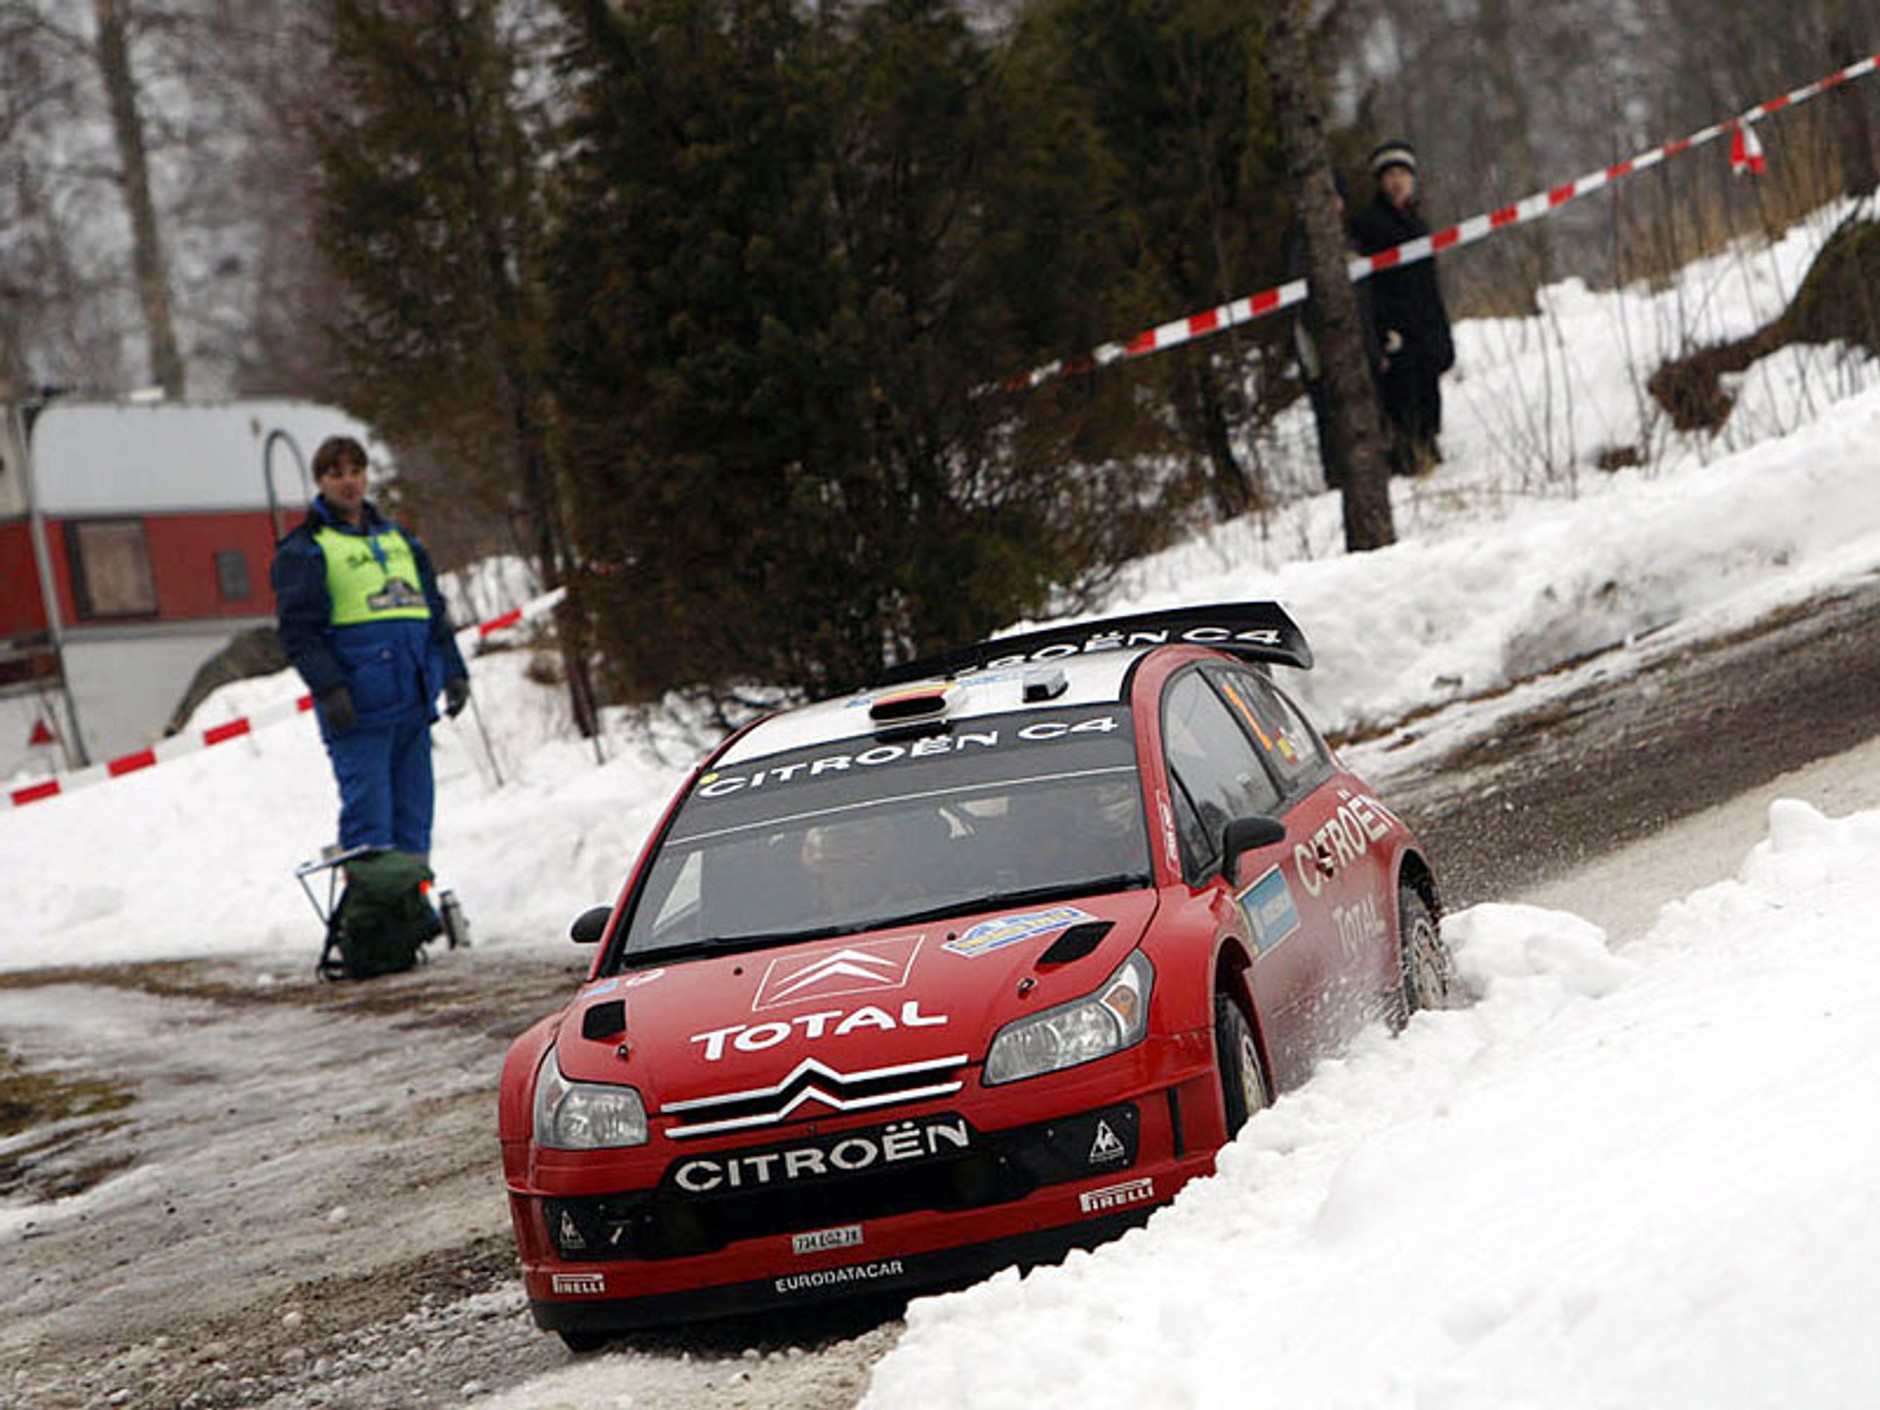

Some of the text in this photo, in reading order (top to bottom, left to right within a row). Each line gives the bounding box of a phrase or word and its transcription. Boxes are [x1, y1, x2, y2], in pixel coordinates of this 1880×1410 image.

[953, 626, 1284, 674] ROËN C4
[699, 716, 1119, 798] CITROËN C4
[1332, 893, 1386, 957] TOTAL
[690, 1001, 949, 1061] TOTAL
[674, 1119, 969, 1191] CITROËN
[1079, 1177, 1154, 1212] PIRELLI
[552, 1273, 606, 1294] PIRELLI
[775, 1260, 903, 1293] EURODATACAR
